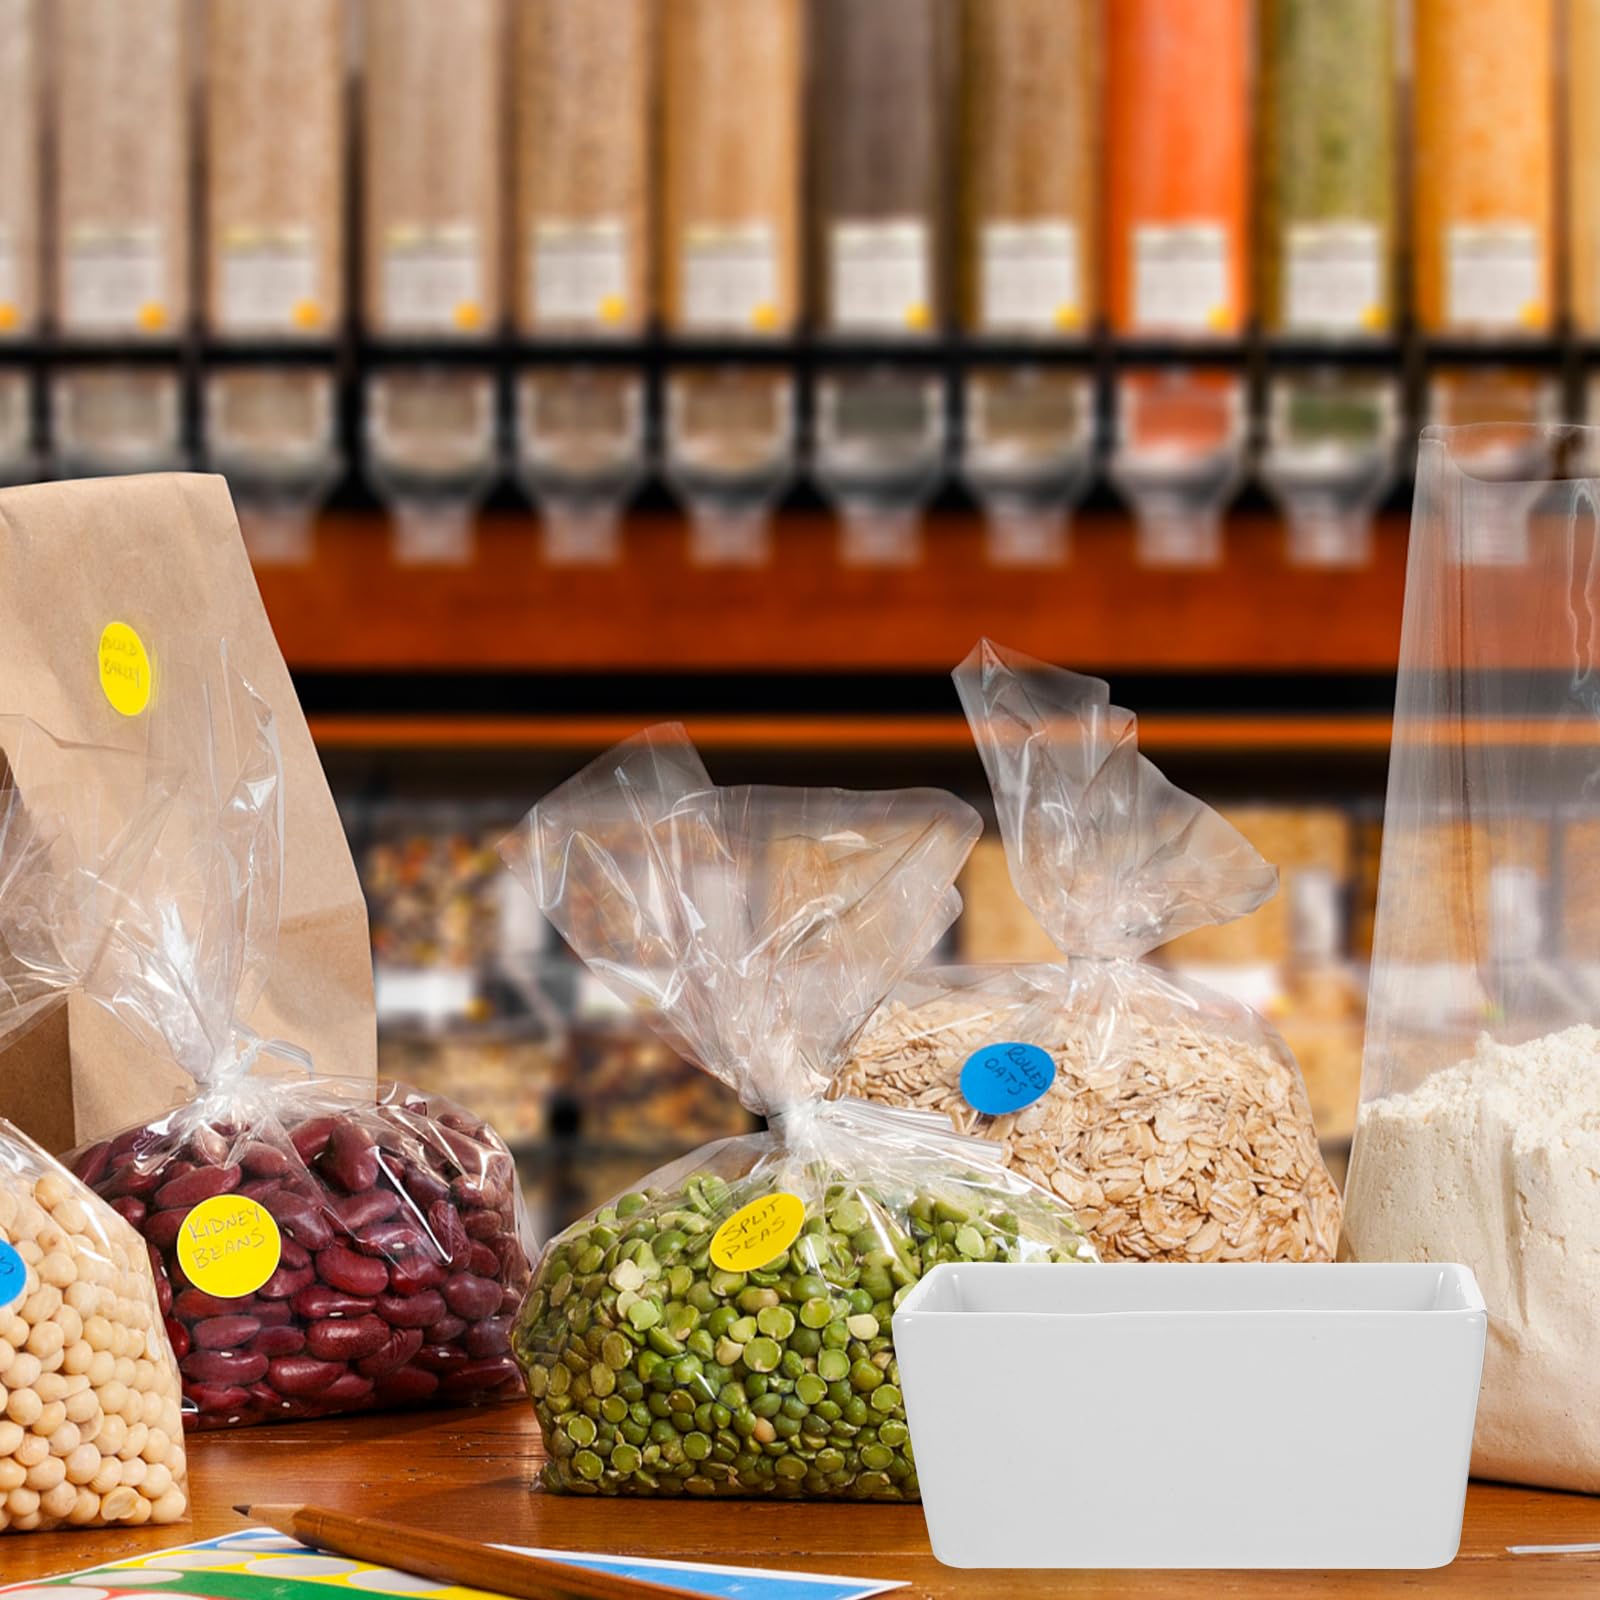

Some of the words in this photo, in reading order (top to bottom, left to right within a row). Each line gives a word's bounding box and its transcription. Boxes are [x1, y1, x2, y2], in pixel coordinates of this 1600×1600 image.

[984, 1058, 1028, 1095] OATS
[1004, 1046, 1047, 1090] ROLLED
[188, 1205, 260, 1244] KIDNEY
[721, 1198, 780, 1242] SPLIT
[721, 1216, 785, 1260] PEAS
[192, 1227, 265, 1269] BEANS
